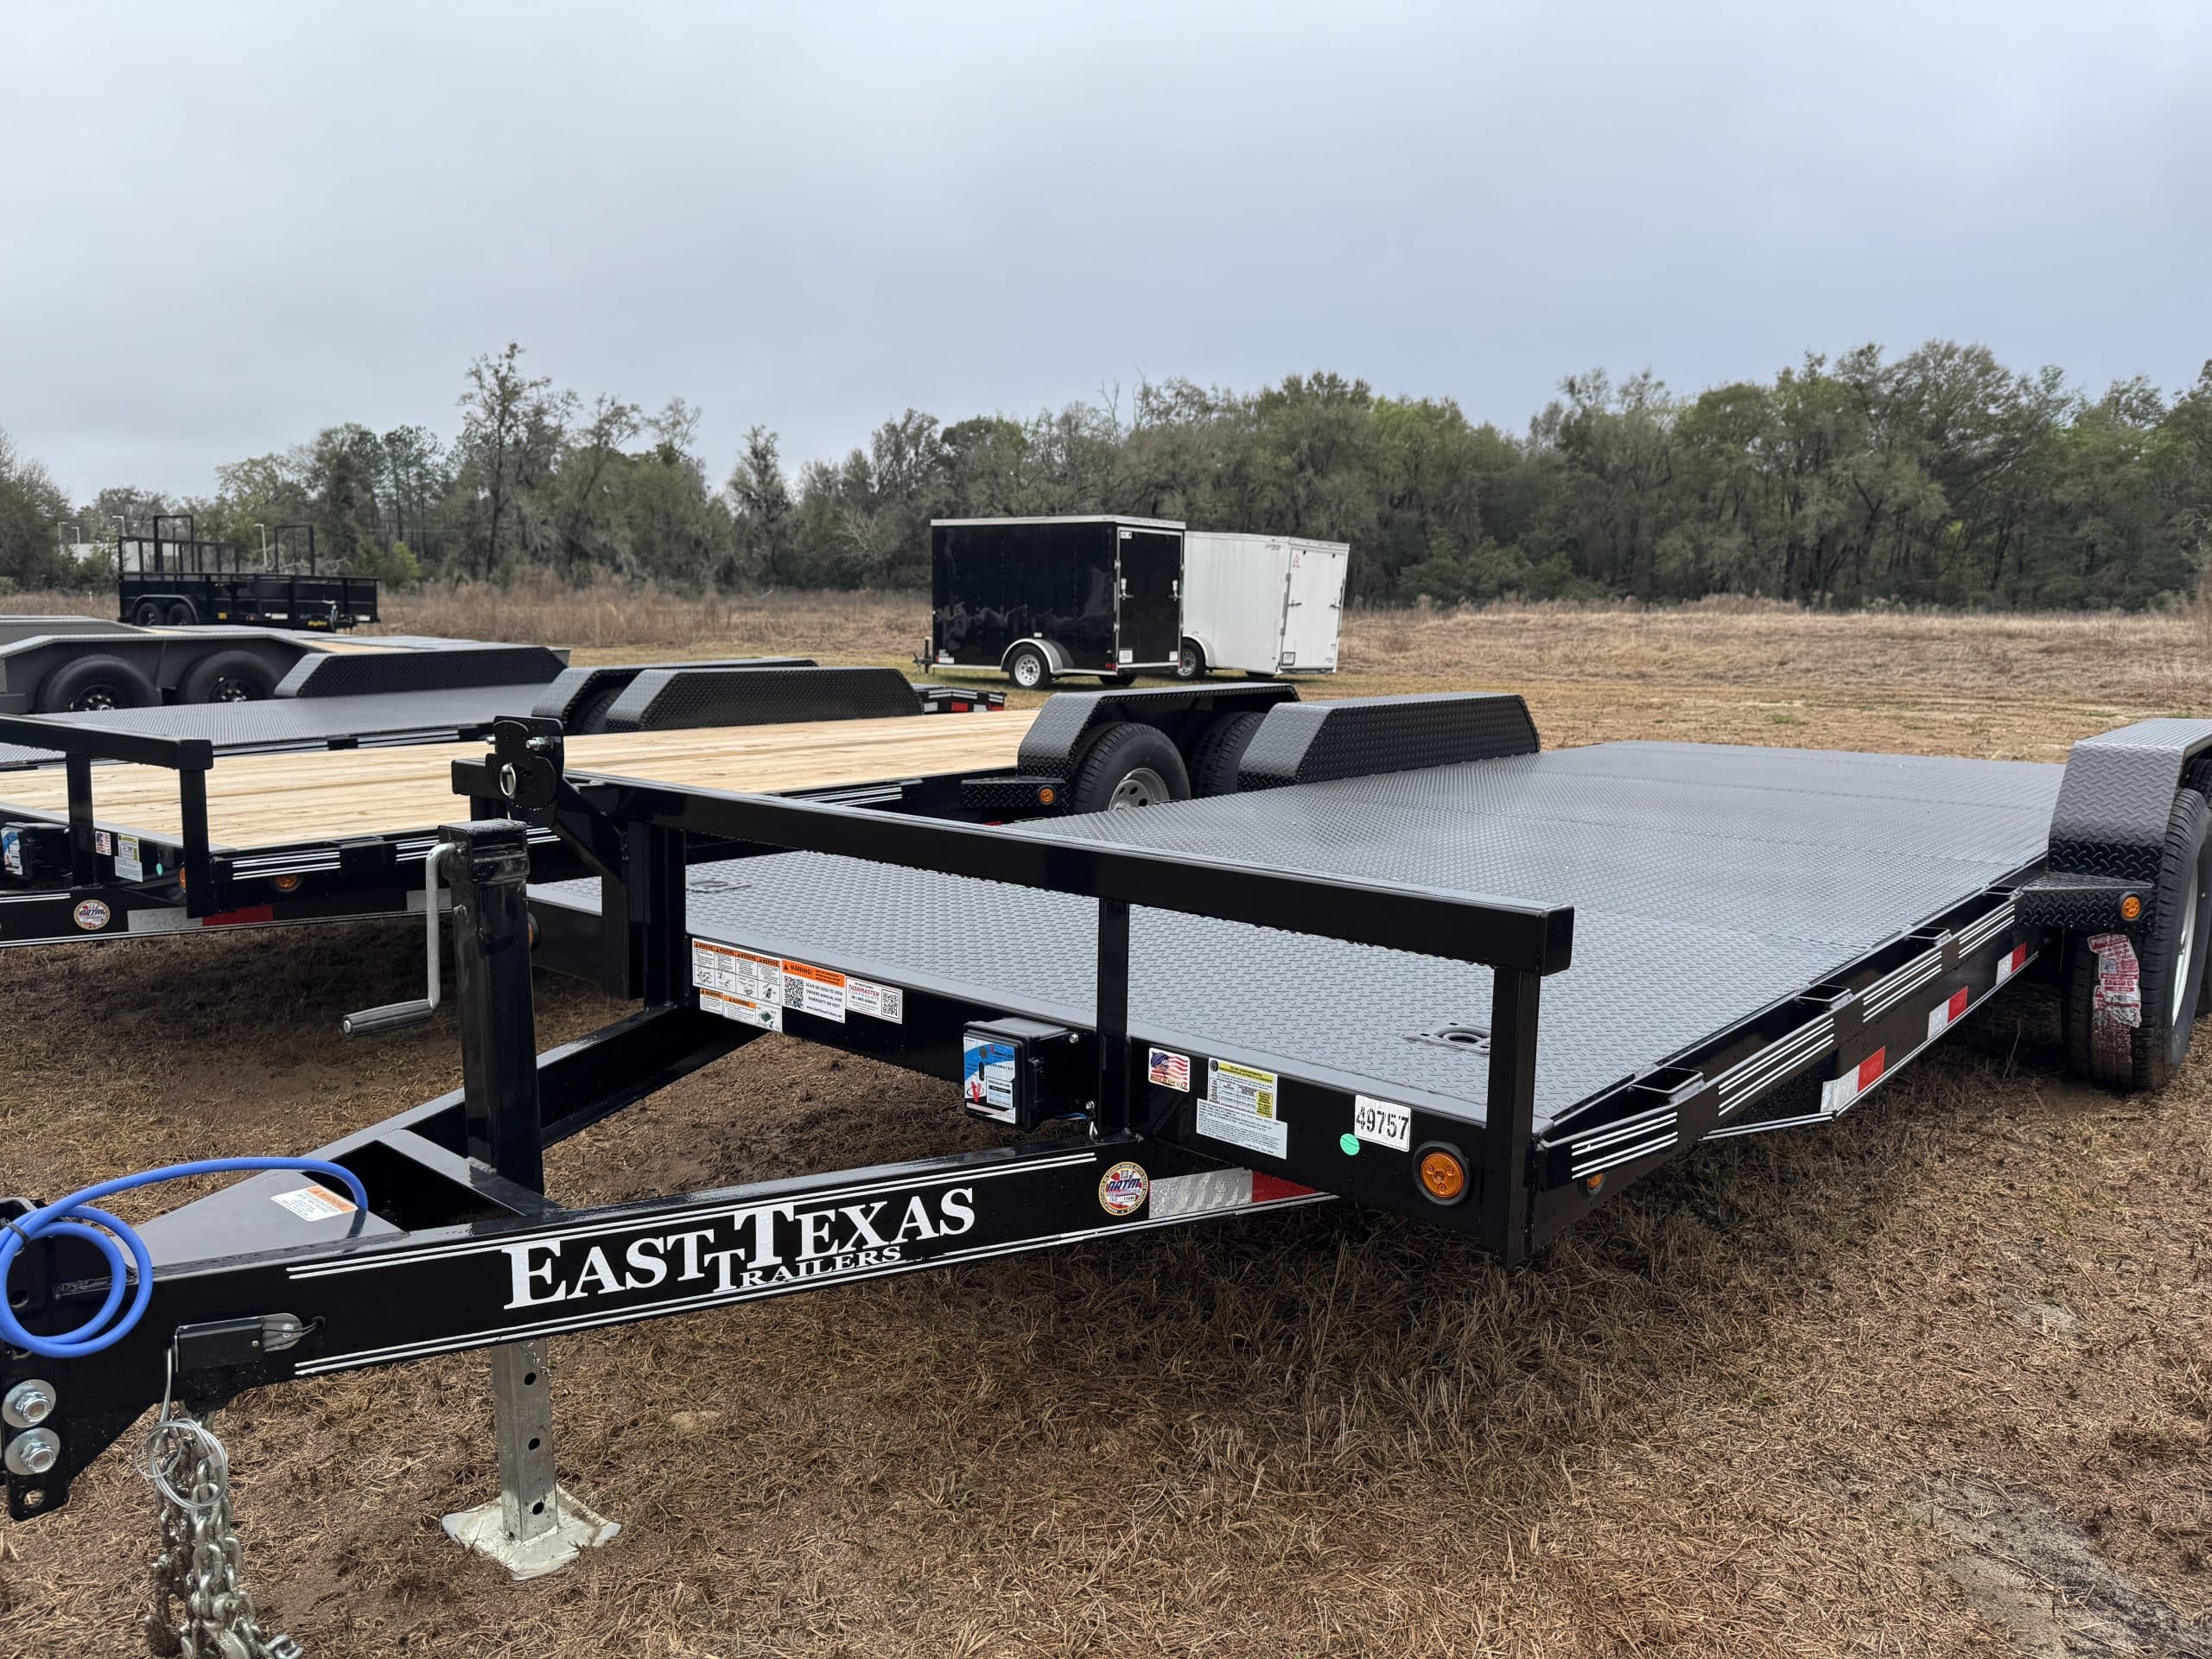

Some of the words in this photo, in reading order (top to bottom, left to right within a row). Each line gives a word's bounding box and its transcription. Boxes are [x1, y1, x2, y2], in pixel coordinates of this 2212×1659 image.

[849, 985, 880, 996] TASKMASTER
[1356, 1106, 1409, 1140] 49757
[500, 1229, 715, 1310] EAST
[734, 1187, 976, 1269] TEXAS
[703, 1246, 902, 1294] TRAILERS
